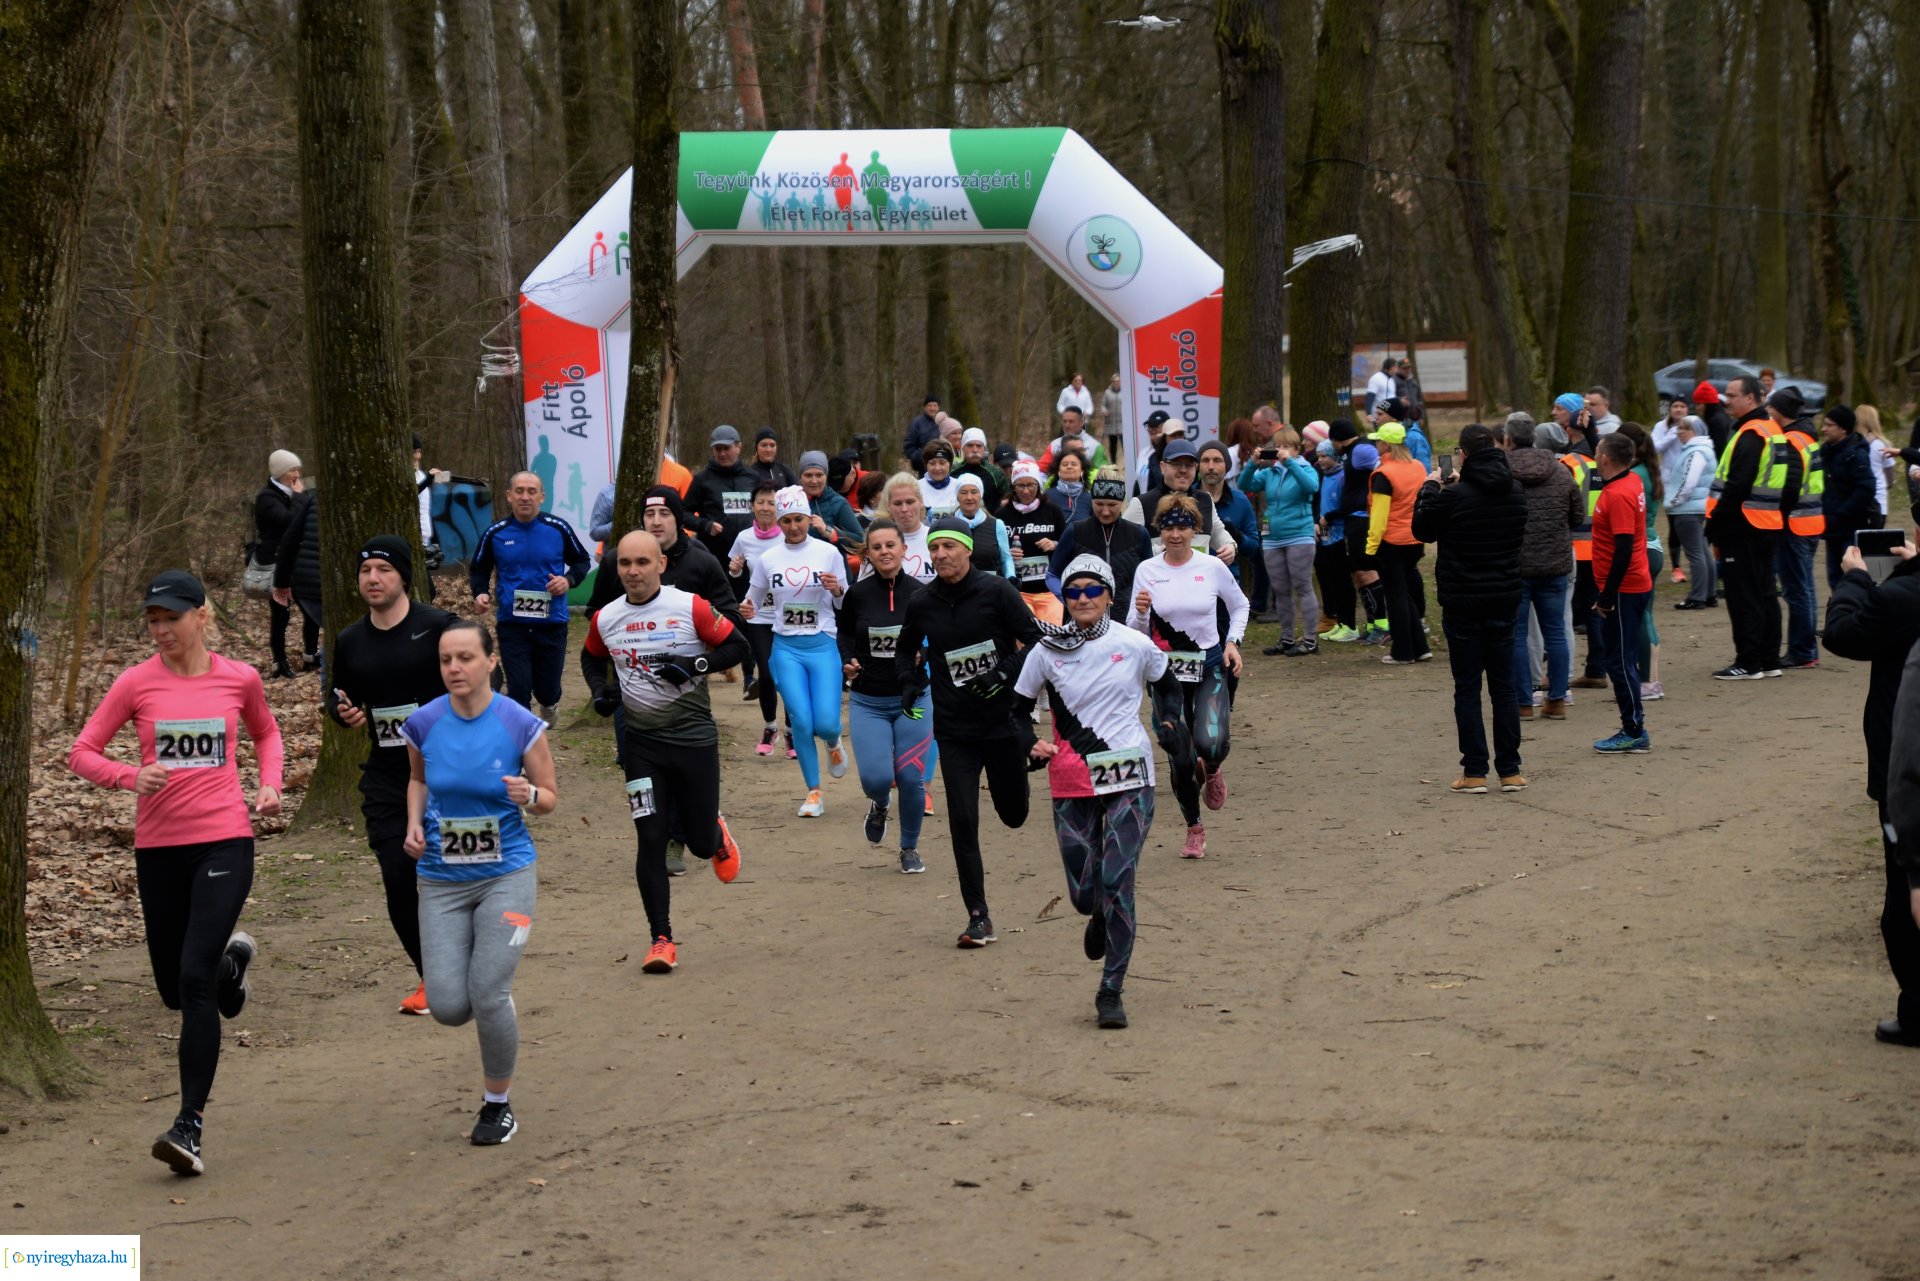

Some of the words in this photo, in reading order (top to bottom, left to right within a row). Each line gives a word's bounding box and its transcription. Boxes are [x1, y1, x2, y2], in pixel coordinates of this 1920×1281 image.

[694, 171, 771, 192] Tegyünk
[777, 171, 853, 189] Közösen
[860, 170, 1019, 193] Magyarországért
[1024, 170, 1032, 188] !
[770, 202, 806, 221] Élet
[812, 204, 872, 221] Forása
[878, 206, 968, 224] Egyesület
[1148, 365, 1170, 406] Fitt
[1171, 328, 1201, 442] Gondozó
[541, 381, 561, 422] Fitt
[561, 364, 592, 439] Ápoló
[725, 498, 747, 510] 210
[1022, 563, 1048, 576] 217
[515, 597, 545, 612] 222
[784, 610, 816, 624] 215
[872, 636, 897, 652] 22
[952, 652, 991, 680] 204
[376, 716, 409, 739] 20
[160, 733, 213, 757] 200
[1093, 759, 1139, 786] 212
[444, 830, 495, 855] 205
